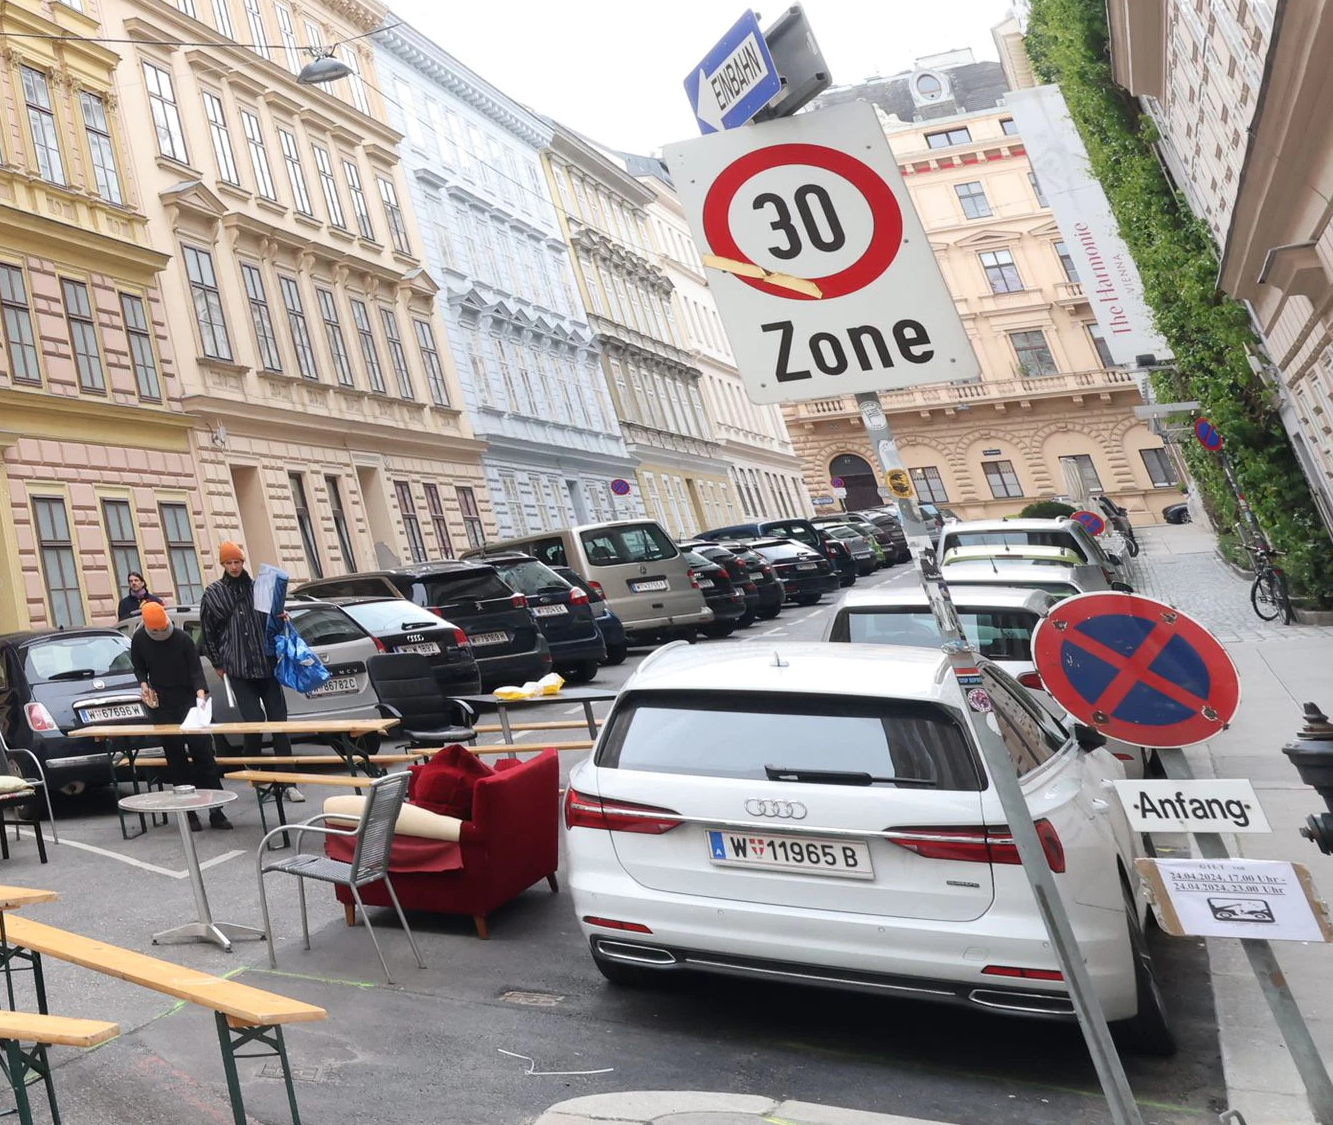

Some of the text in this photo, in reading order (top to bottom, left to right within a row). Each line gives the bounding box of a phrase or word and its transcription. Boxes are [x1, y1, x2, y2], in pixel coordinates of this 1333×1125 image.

[711, 41, 762, 111] EINBAHN
[752, 183, 846, 260] 30
[1074, 221, 1132, 336] The Harmonie
[1113, 253, 1135, 294] VIENNA
[761, 319, 934, 383] Zone
[1139, 791, 1250, 827] Anfang
[730, 837, 858, 868] W 11965 B
[1257, 875, 1278, 884] Uhr
[1263, 886, 1285, 895] Uhr
